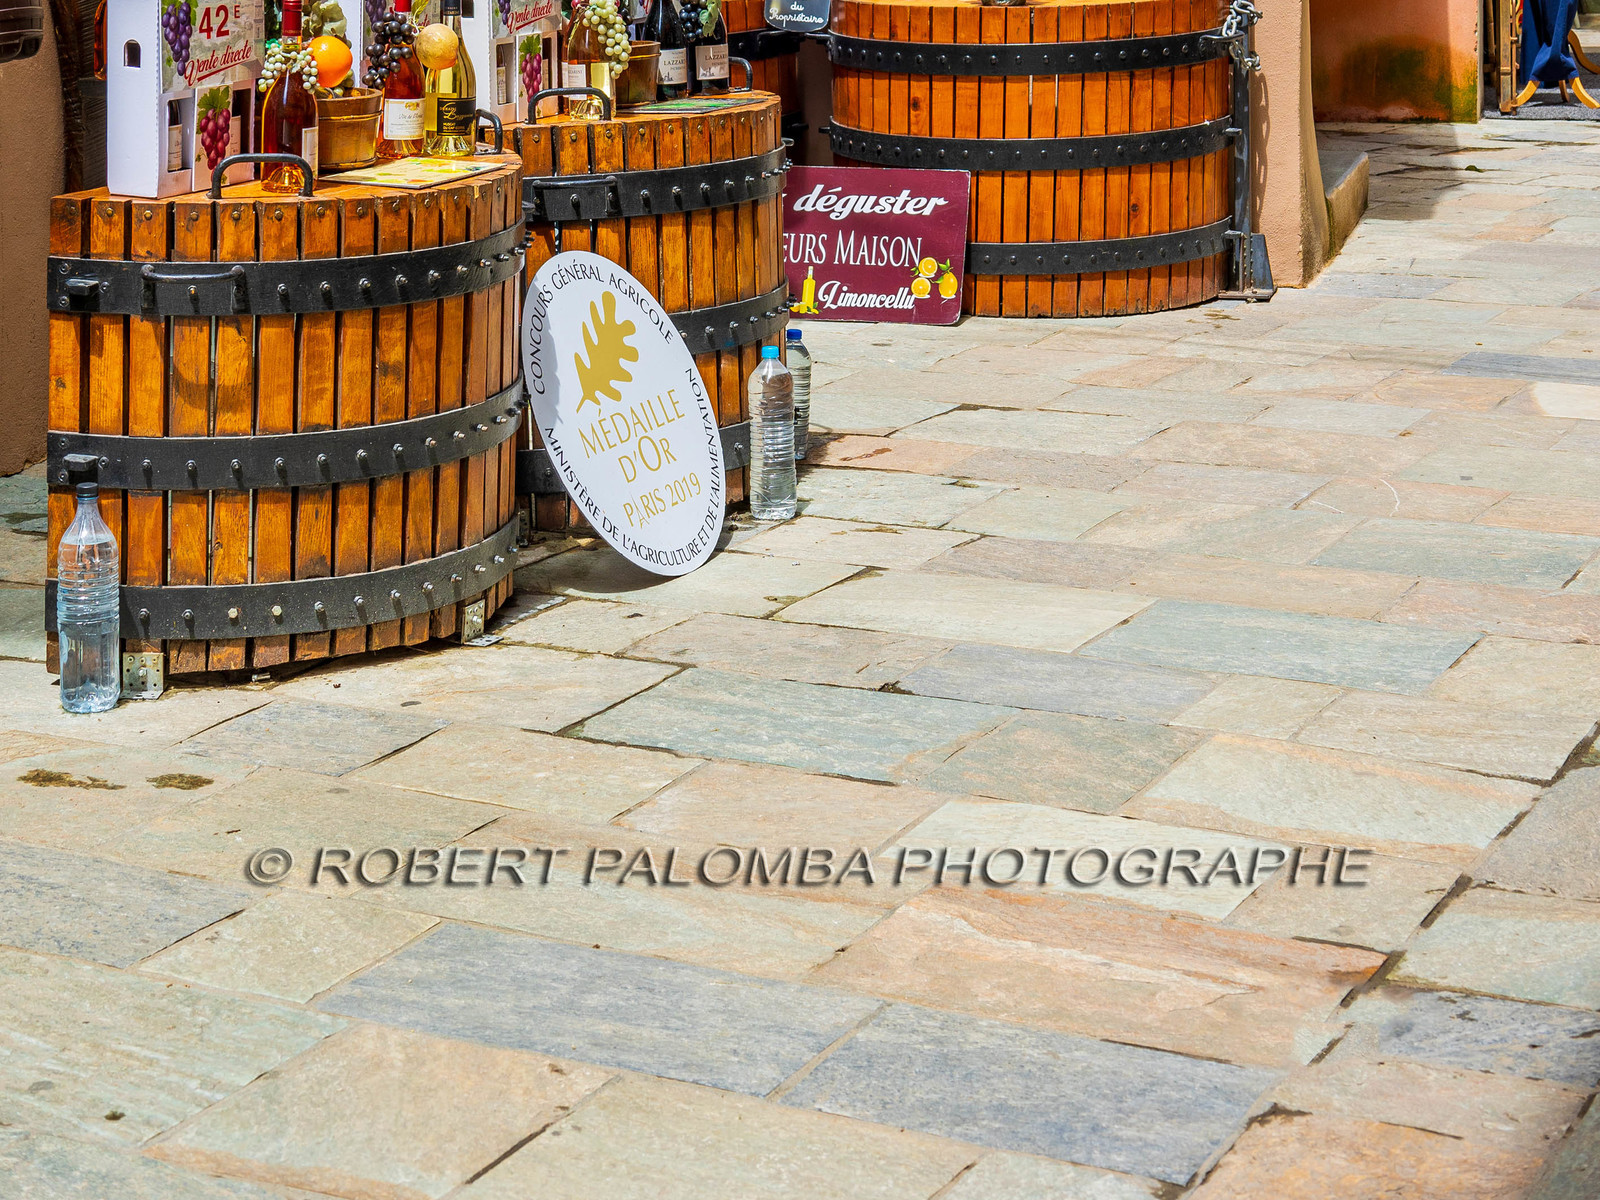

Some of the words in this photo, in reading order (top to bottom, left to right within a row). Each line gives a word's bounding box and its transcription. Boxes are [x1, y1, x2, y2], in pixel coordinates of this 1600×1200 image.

[507, 5, 530, 34] Vente
[769, 7, 824, 28] Propriétaire
[790, 1, 804, 11] du
[184, 50, 218, 87] Vente
[220, 40, 252, 66] directe
[793, 184, 948, 221] déguster
[783, 233, 828, 267] EURS
[833, 230, 922, 267] MAISON
[529, 285, 554, 394] CONCOURS
[551, 259, 604, 290] GÉNÉRAL
[609, 273, 674, 344] AGRICOLE
[578, 389, 686, 459] MÉDAILLE
[685, 368, 721, 509] L'ALIMENTATION
[544, 427, 601, 521] MINISTÈRE
[618, 435, 677, 484] D'OR
[623, 488, 667, 529] PARIS
[665, 472, 701, 507] 2019
[705, 506, 718, 532] DE
[602, 514, 619, 542] DE
[697, 527, 710, 547] ET
[623, 533, 702, 567] L'AGRICULTURE
